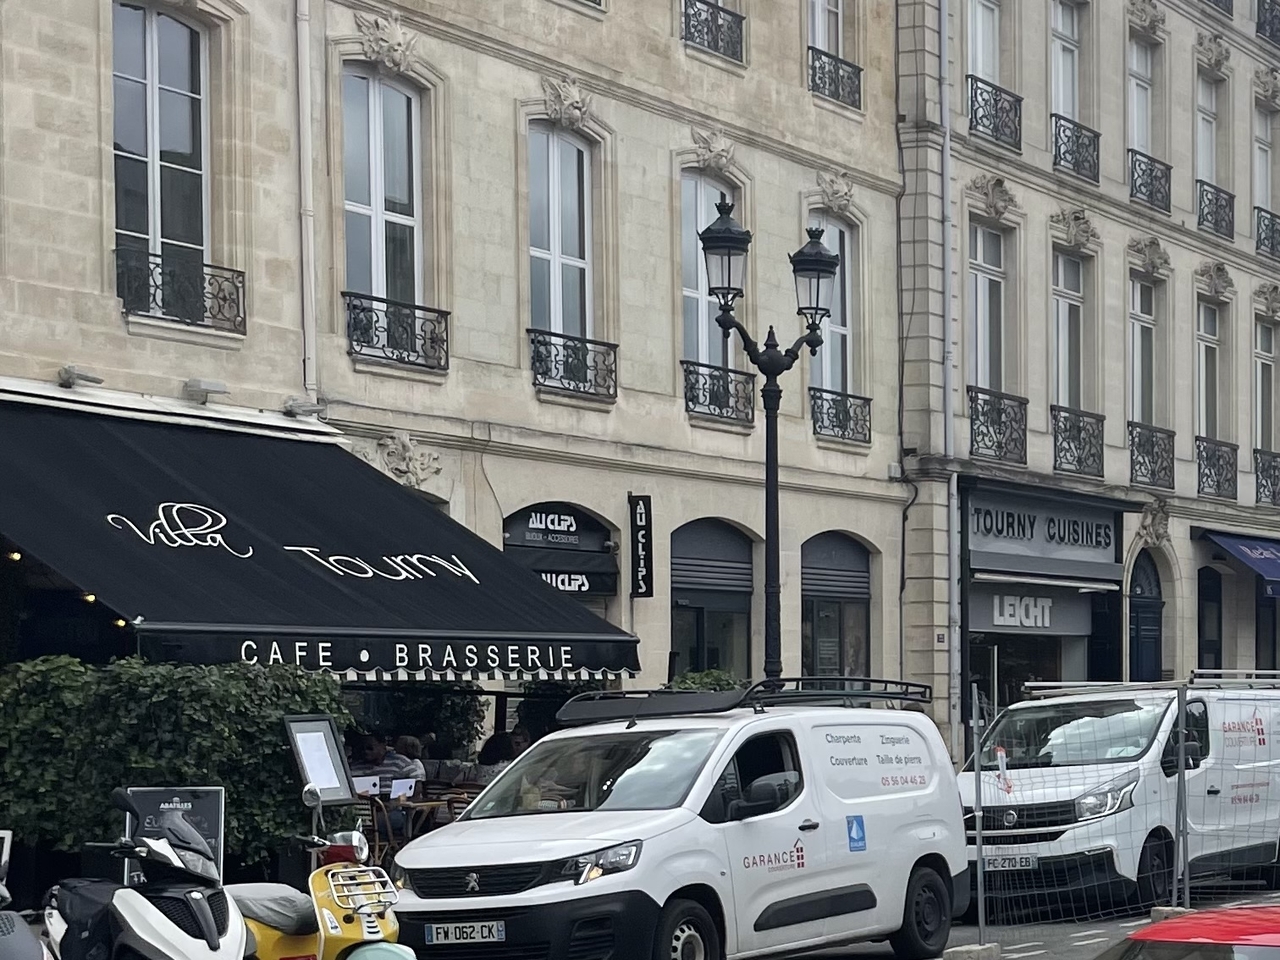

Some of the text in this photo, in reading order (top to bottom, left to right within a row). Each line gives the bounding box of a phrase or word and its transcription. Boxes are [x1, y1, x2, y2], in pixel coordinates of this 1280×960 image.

[528, 512, 546, 529] AU
[973, 507, 1112, 548] TOURNY CUISINES
[106, 502, 480, 584] Villa Tourny
[992, 594, 1053, 628] LEICHT
[240, 640, 573, 668] CAFE BRASSERIE
[1222, 720, 1256, 733] GARANCE
[825, 733, 862, 745] Charpente
[879, 734, 910, 747] Zinguerie
[829, 755, 869, 767] Couverture
[876, 754, 923, 767] Taille de pierre
[743, 850, 796, 870] GARANCE
[435, 924, 496, 941] FW-062-CK
